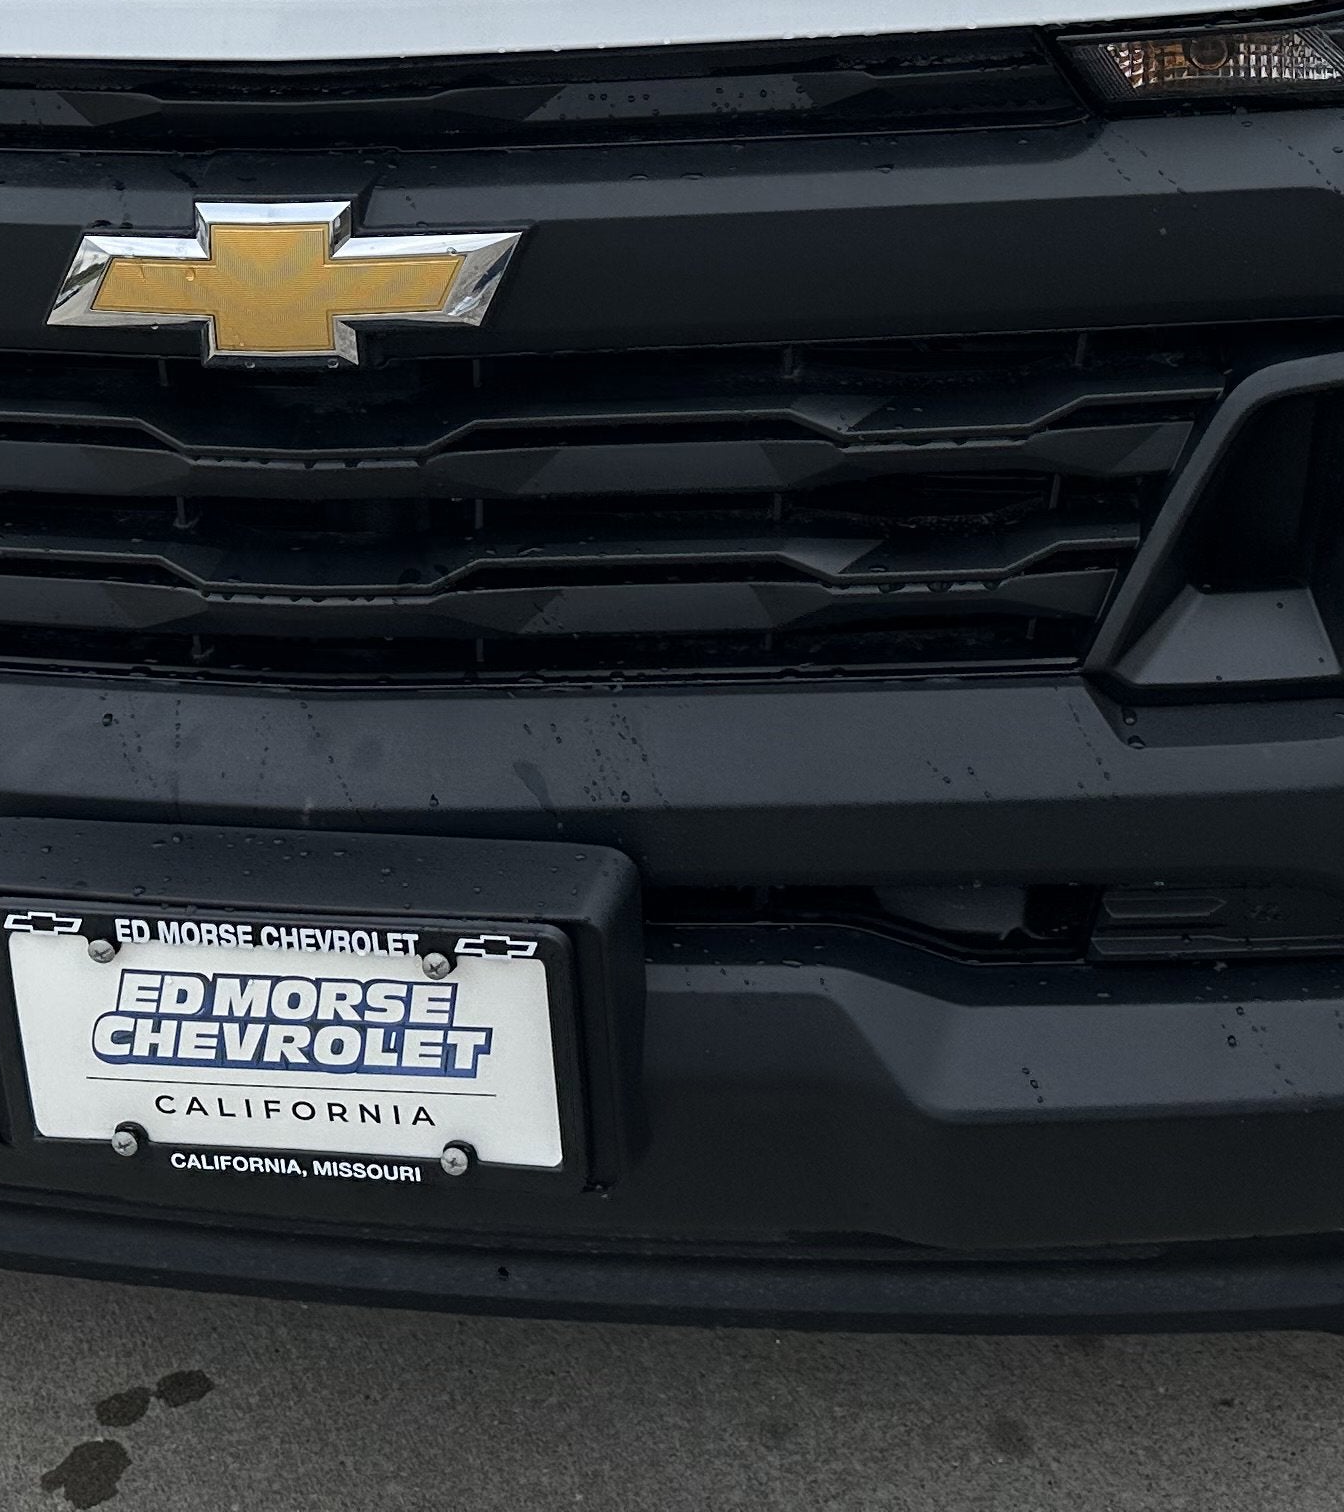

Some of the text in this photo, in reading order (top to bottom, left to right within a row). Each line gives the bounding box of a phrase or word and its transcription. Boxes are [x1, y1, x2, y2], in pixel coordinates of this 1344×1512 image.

[114, 918, 419, 957] ED MORSE CHEVROLET
[116, 969, 458, 1028] ED MORSE
[91, 1011, 493, 1079] CHEVROLET
[154, 1093, 437, 1128] CALIFORNIA
[170, 1152, 422, 1183] CALIFORNIA, MISSOURI
